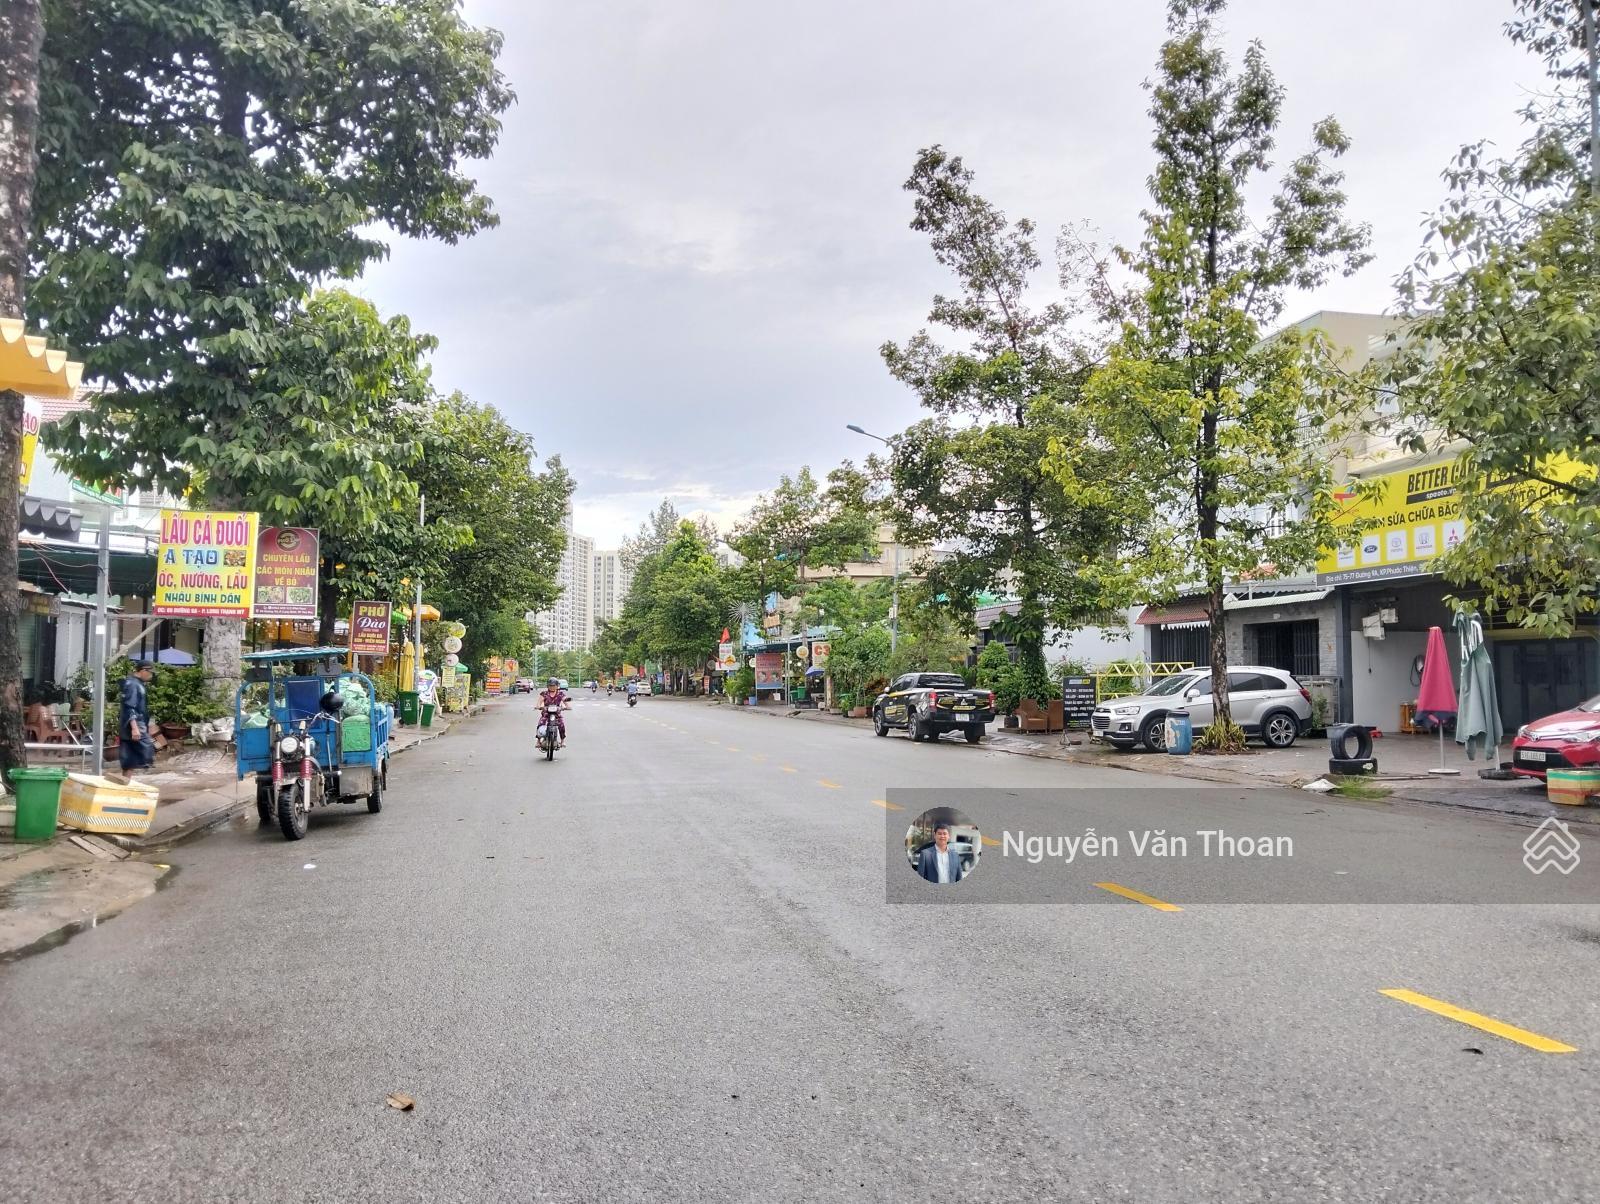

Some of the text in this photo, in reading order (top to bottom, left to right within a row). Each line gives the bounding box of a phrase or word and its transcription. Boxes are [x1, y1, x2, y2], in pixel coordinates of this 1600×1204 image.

[1408, 466, 1449, 494] BETTER
[1388, 511, 1406, 527] SỬA
[1408, 505, 1436, 523] CHỮA
[193, 514, 212, 545] CÁ
[216, 511, 249, 546] ĐUỐI
[183, 549, 218, 569] TẠO
[256, 565, 273, 575] CÁC
[180, 571, 223, 591] NƯỚNG,
[358, 603, 386, 617] PHỞ
[356, 616, 386, 629] Đào
